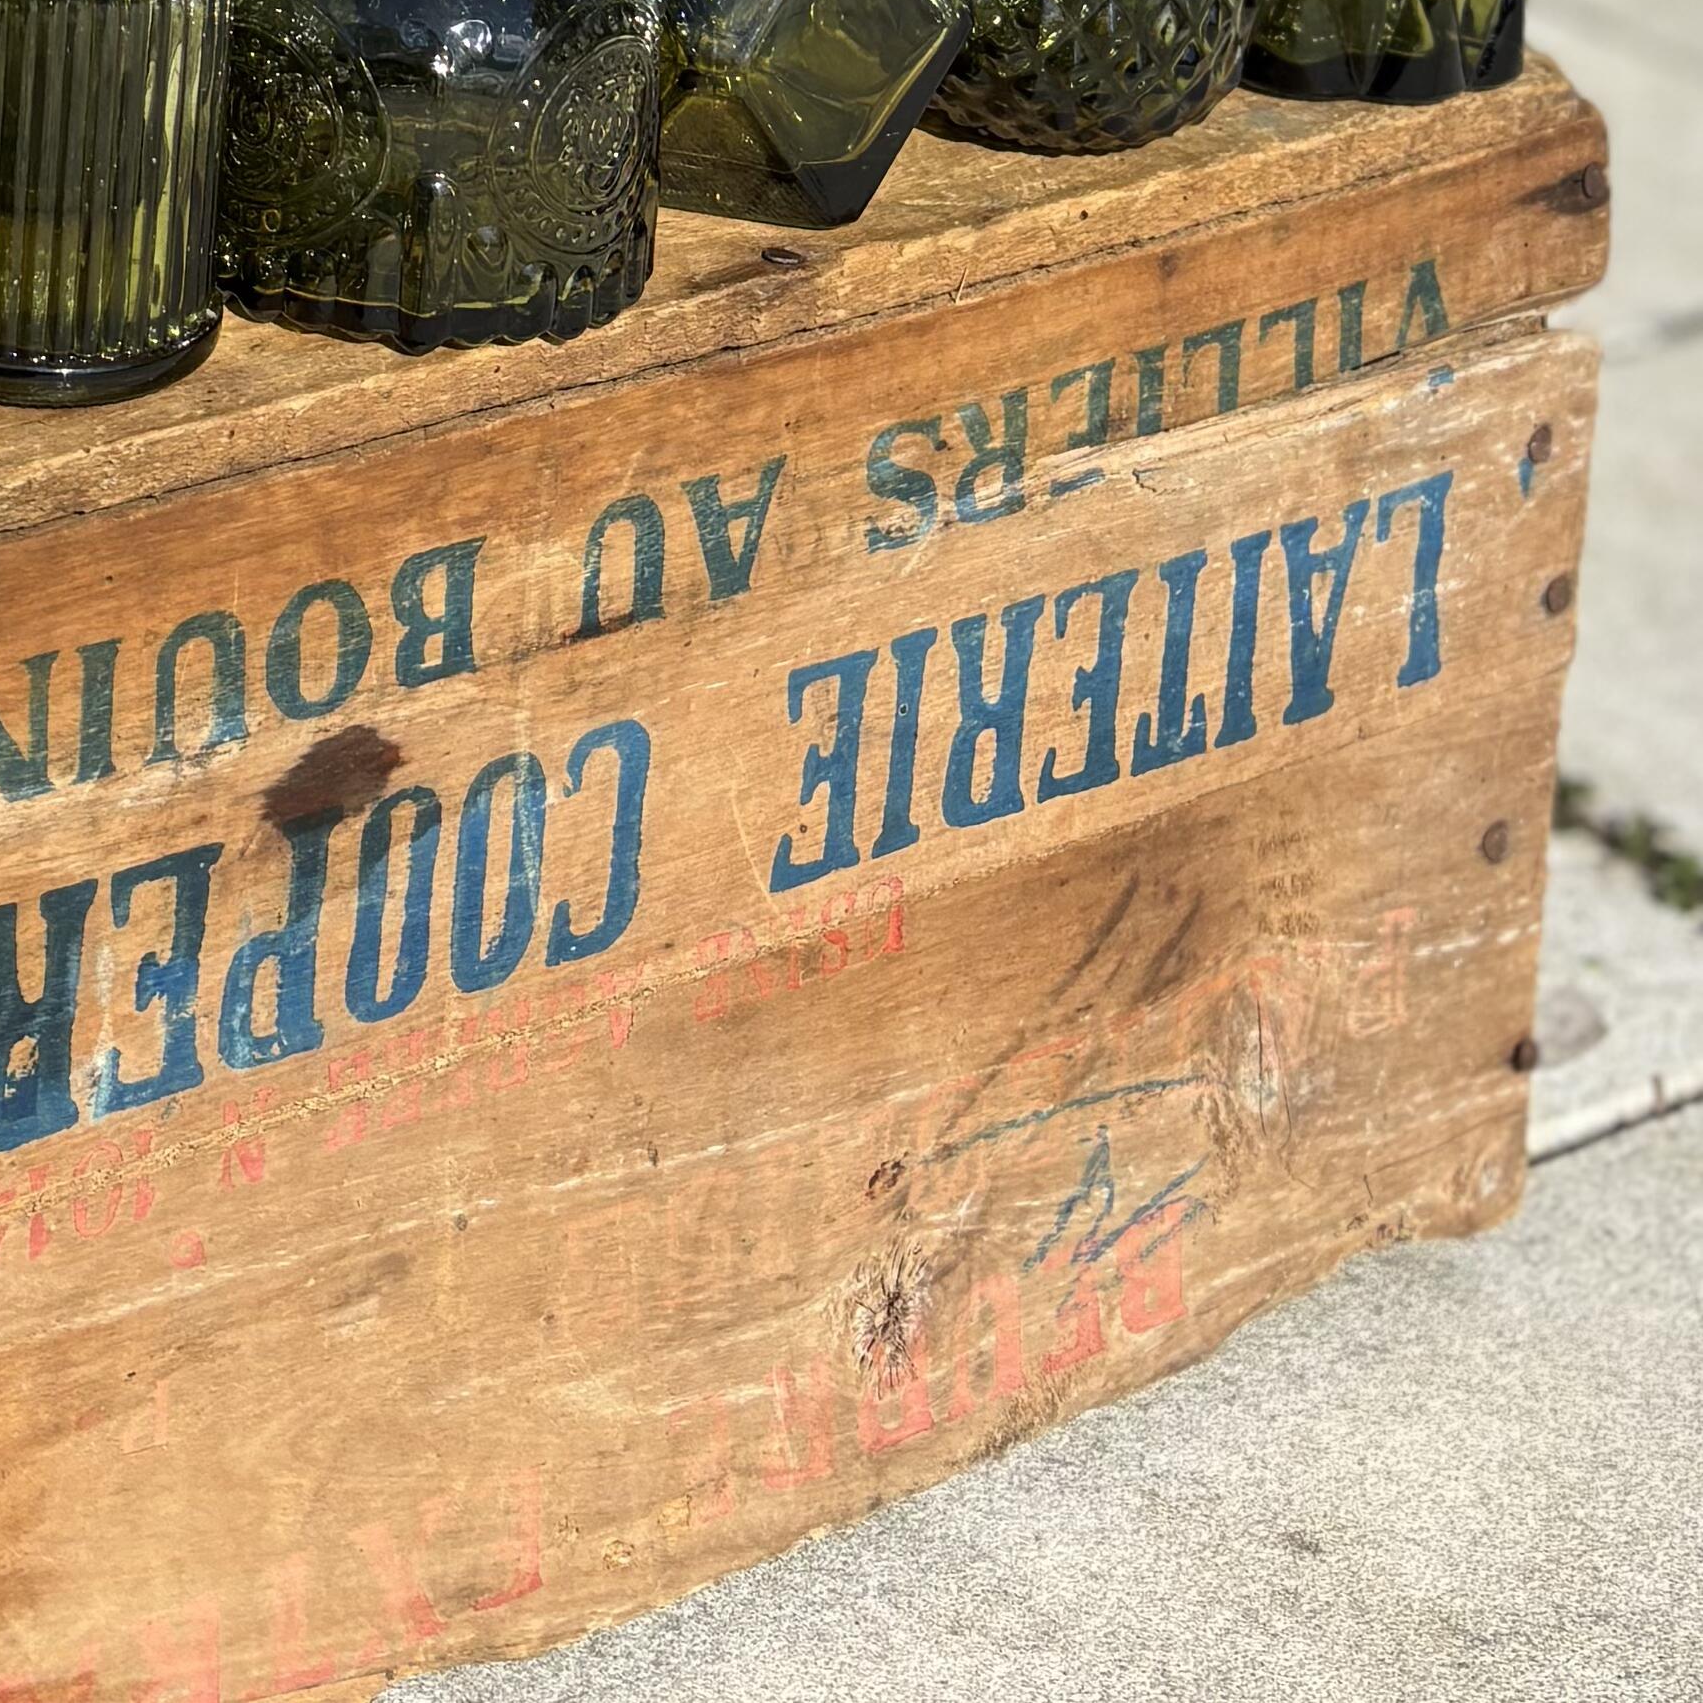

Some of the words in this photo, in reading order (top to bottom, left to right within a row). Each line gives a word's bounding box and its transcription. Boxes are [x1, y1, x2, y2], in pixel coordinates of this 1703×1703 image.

[865, 258, 1454, 553] VILLIERS
[572, 453, 786, 641] AU
[769, 472, 1453, 895] LAITERIE
[690, 876, 908, 1023] USINE
